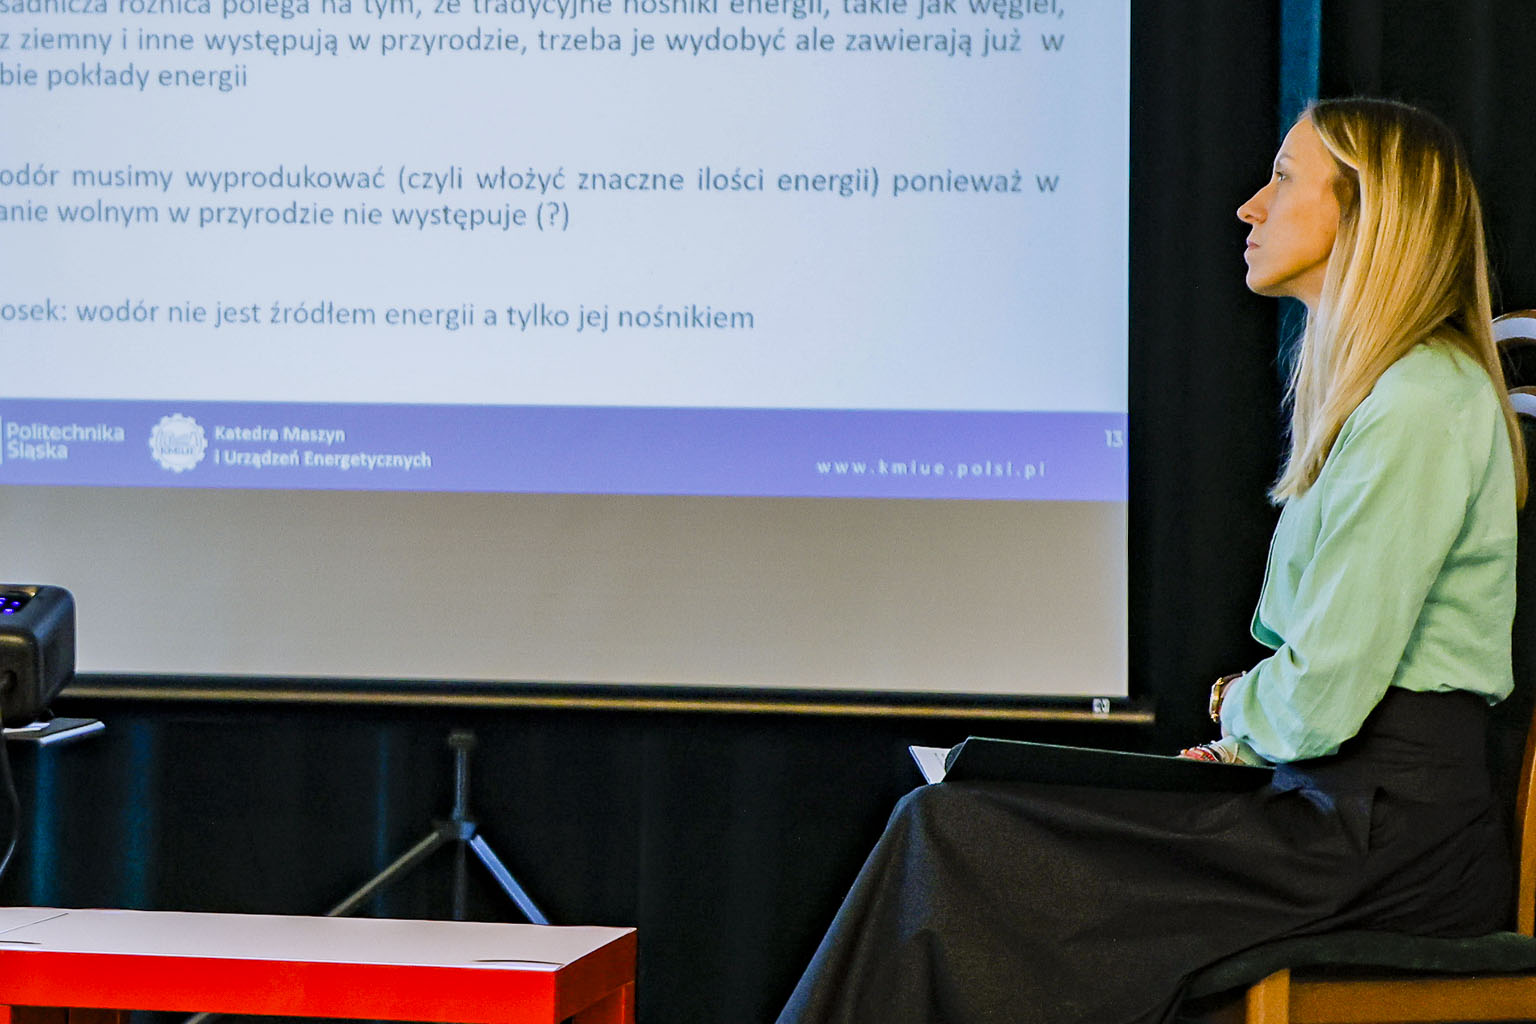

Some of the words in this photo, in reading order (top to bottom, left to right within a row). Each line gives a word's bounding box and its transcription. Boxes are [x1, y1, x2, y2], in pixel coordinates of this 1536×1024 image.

[21, 28, 112, 55] ziemny
[122, 28, 128, 49] i
[139, 28, 194, 50] inne
[205, 29, 337, 56] występują
[349, 34, 370, 50] w
[382, 27, 526, 56] przyrodzie,
[538, 27, 621, 51] trzeba
[631, 28, 654, 56] je
[666, 26, 785, 56] wydobyć
[796, 27, 835, 51] ale
[846, 28, 971, 57] zawierają
[982, 28, 1020, 57] już
[1041, 34, 1064, 51] w
[48, 62, 149, 91] pokłady
[158, 65, 246, 92] energii
[73, 165, 173, 192] musimy
[186, 165, 384, 192] wyprodukować
[399, 165, 462, 194] (czyli
[477, 166, 564, 195] włożyć
[579, 173, 684, 190] znaczne
[698, 166, 763, 191] ilości
[778, 167, 879, 197] energii)
[893, 169, 1022, 197] ponieważ
[1036, 175, 1059, 192] w
[58, 199, 158, 228] wolnym
[169, 207, 190, 223] w
[200, 201, 334, 229] przyrodzie
[344, 203, 382, 224] nie
[392, 204, 526, 231] występuje
[537, 202, 569, 231] (?)
[77, 299, 158, 322] wodór
[169, 301, 206, 322] nie
[215, 302, 261, 328] jest
[271, 301, 375, 324] źródłem
[385, 304, 473, 331] energii
[484, 309, 497, 326] a
[507, 303, 569, 332] tylko
[577, 305, 608, 333] jej
[619, 304, 753, 328] nośnikiem
[7, 423, 124, 441] Politechnika
[215, 426, 278, 441] Katedra
[283, 427, 345, 446] Maszyn
[7, 442, 68, 461] Śląska
[224, 450, 300, 468] Urządzeń
[305, 452, 431, 470] Energetycznych
